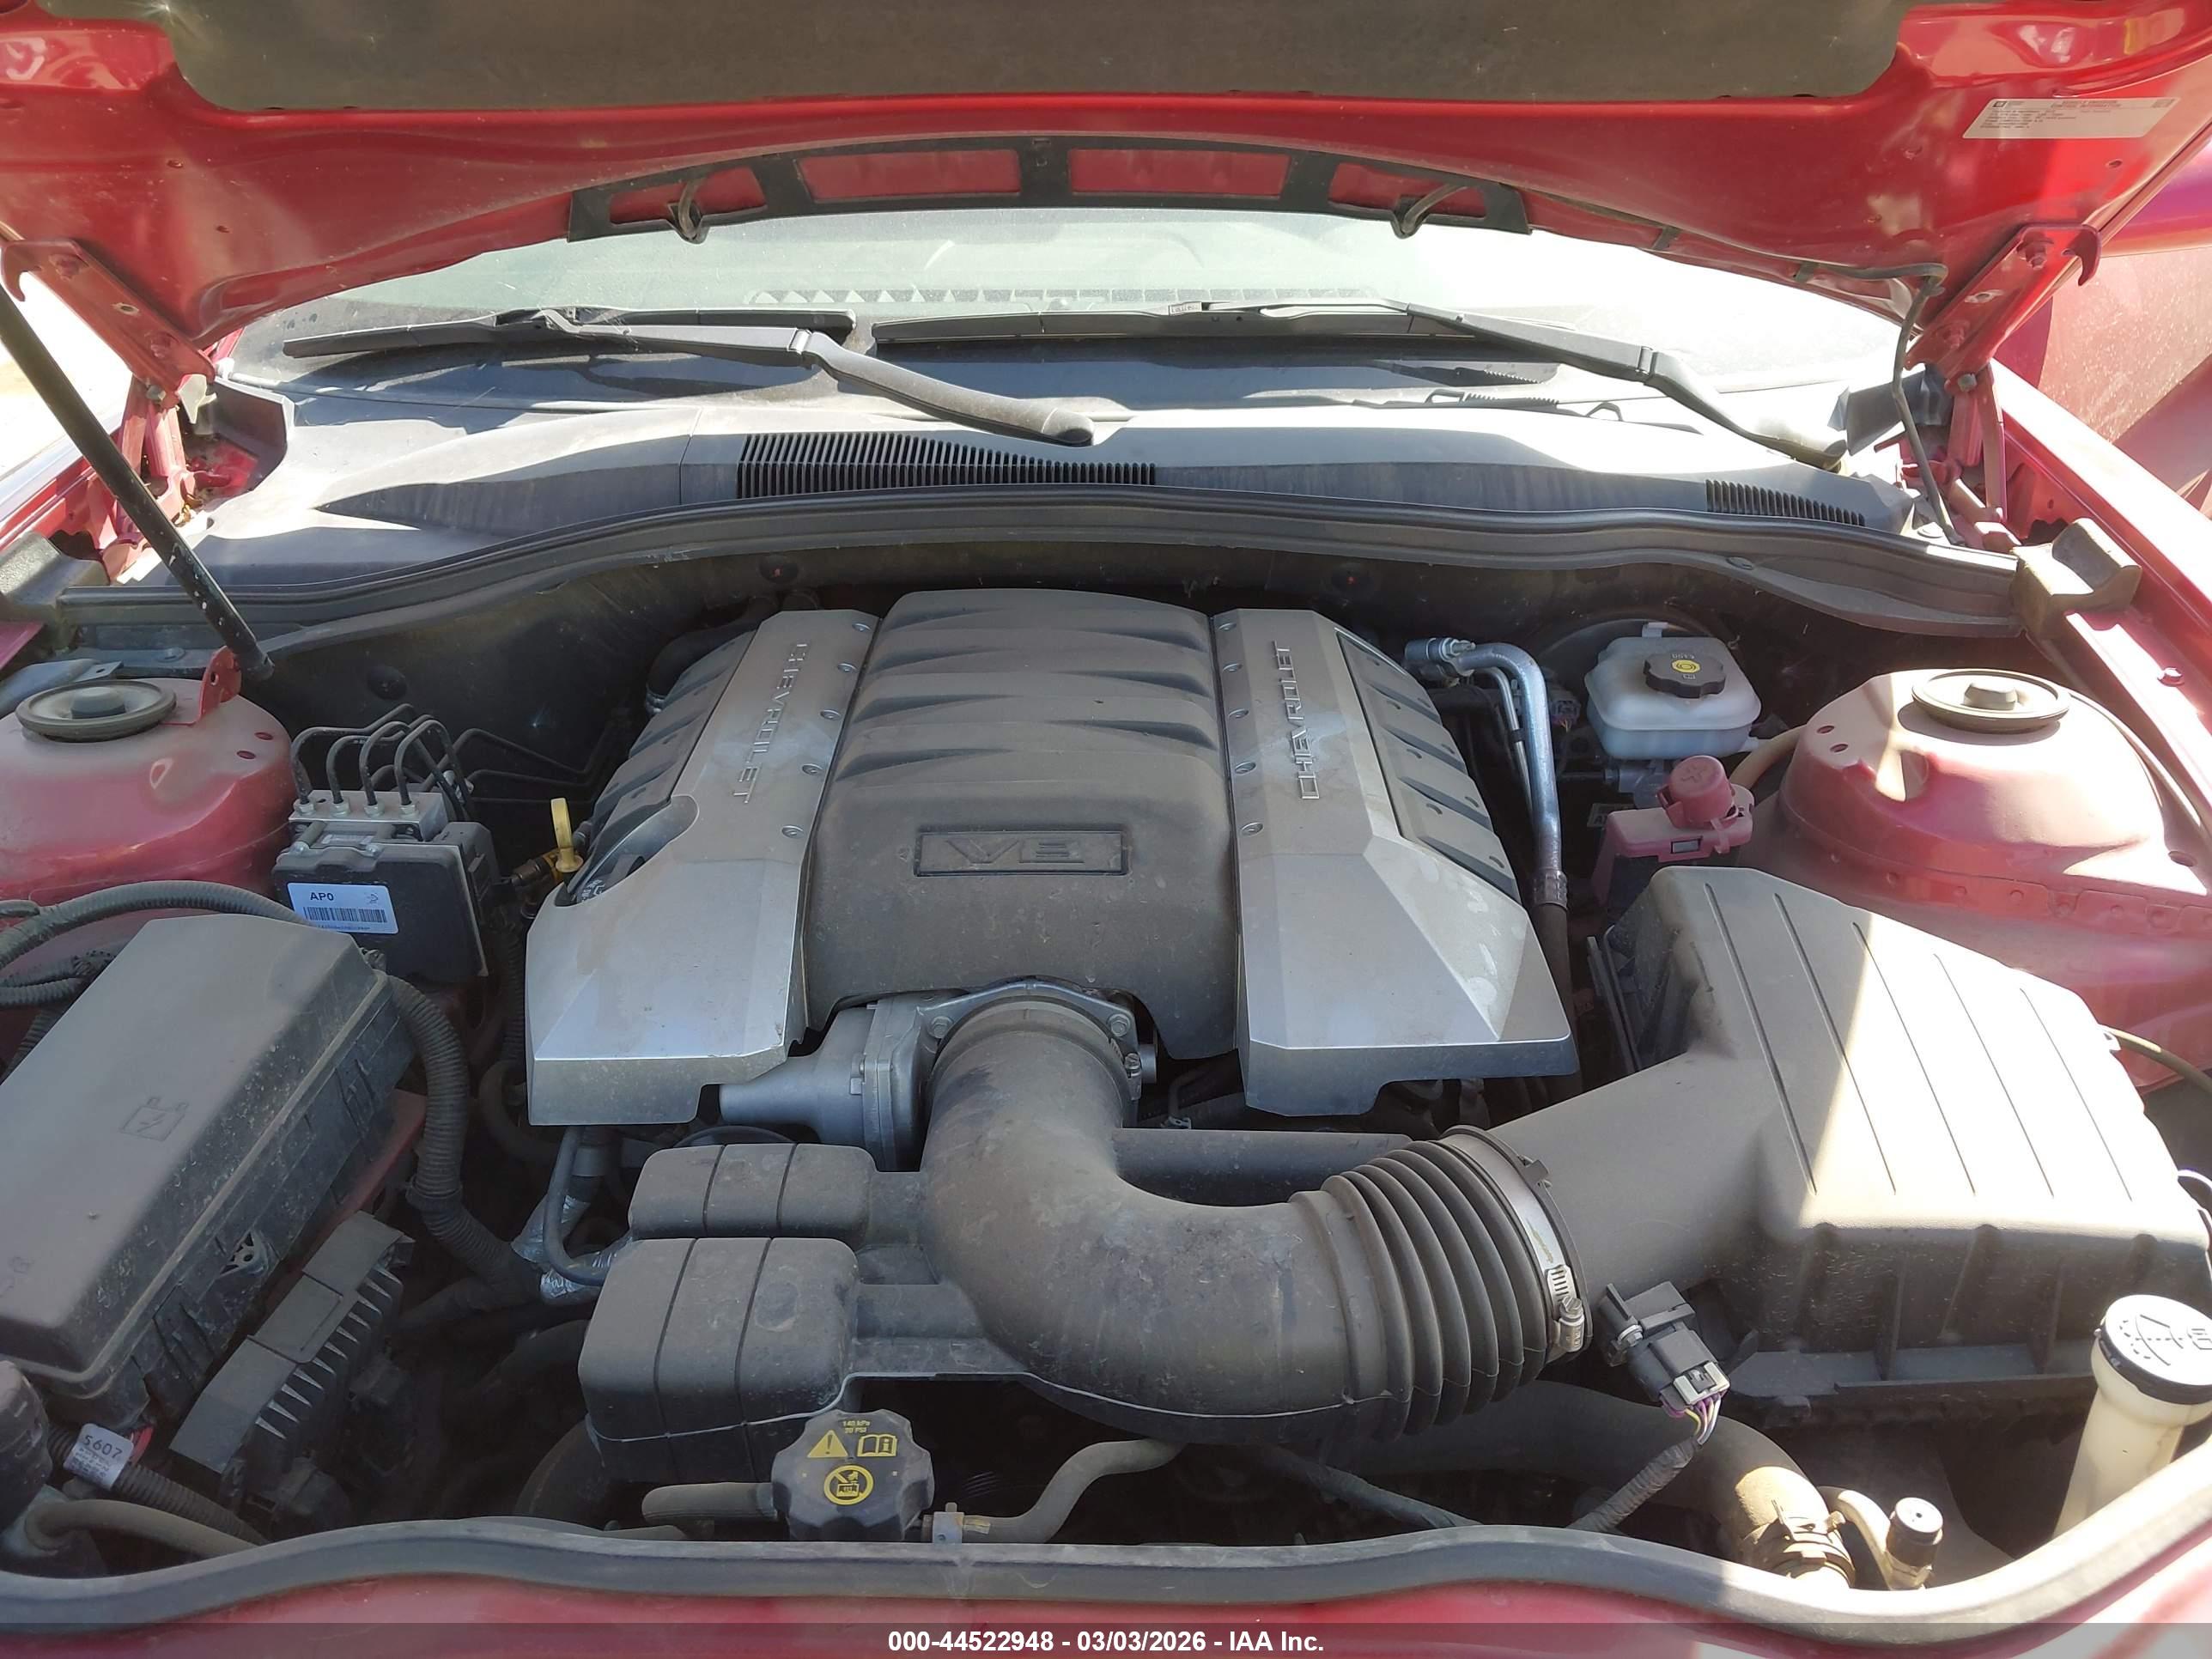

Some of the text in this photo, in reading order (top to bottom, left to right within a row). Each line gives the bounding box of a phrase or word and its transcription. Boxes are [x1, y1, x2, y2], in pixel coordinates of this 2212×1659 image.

[732, 641, 809, 804] CHEVROLET
[1272, 640, 1321, 800] CHEVROLET
[944, 836, 1085, 866] V8
